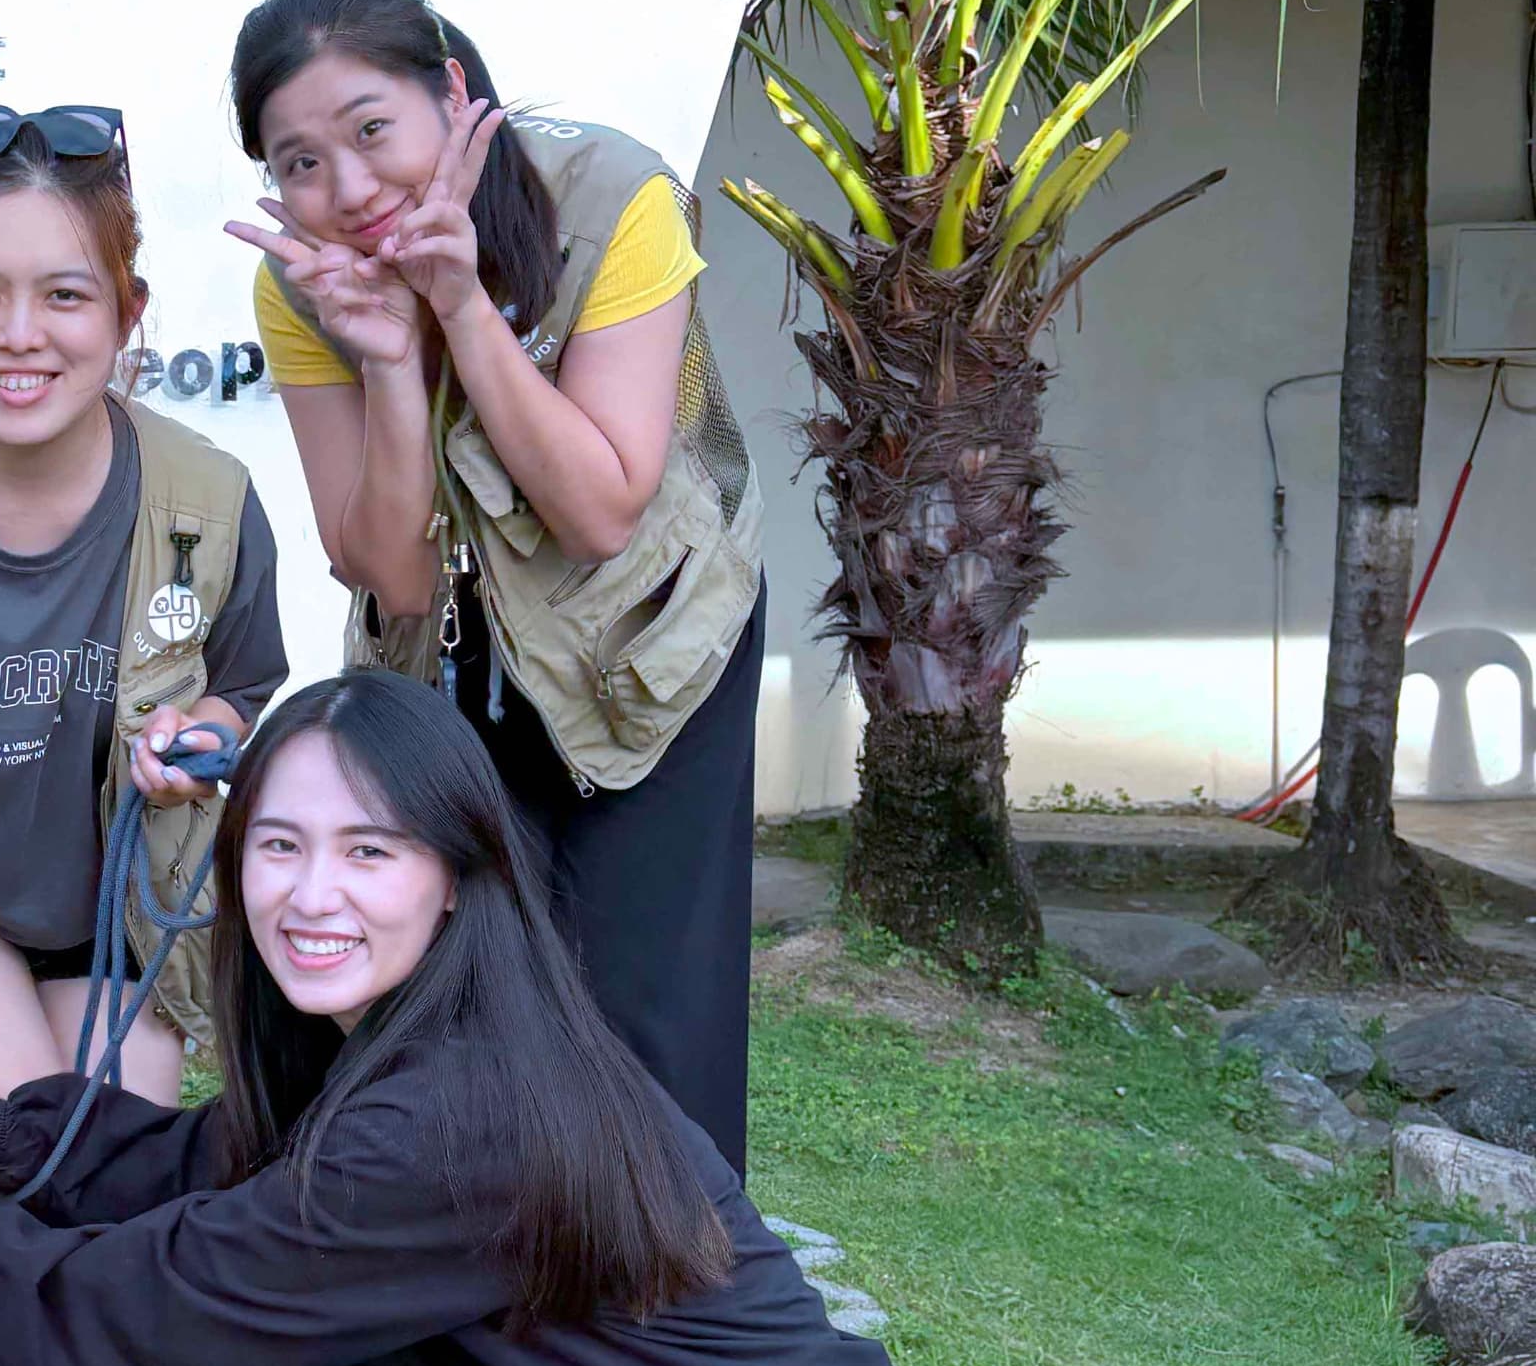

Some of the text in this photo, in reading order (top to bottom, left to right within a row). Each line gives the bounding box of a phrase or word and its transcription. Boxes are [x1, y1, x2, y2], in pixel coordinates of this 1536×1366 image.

[529, 334, 558, 362] UDY
[12, 739, 44, 751] VISUAL
[4, 753, 32, 766] YORK
